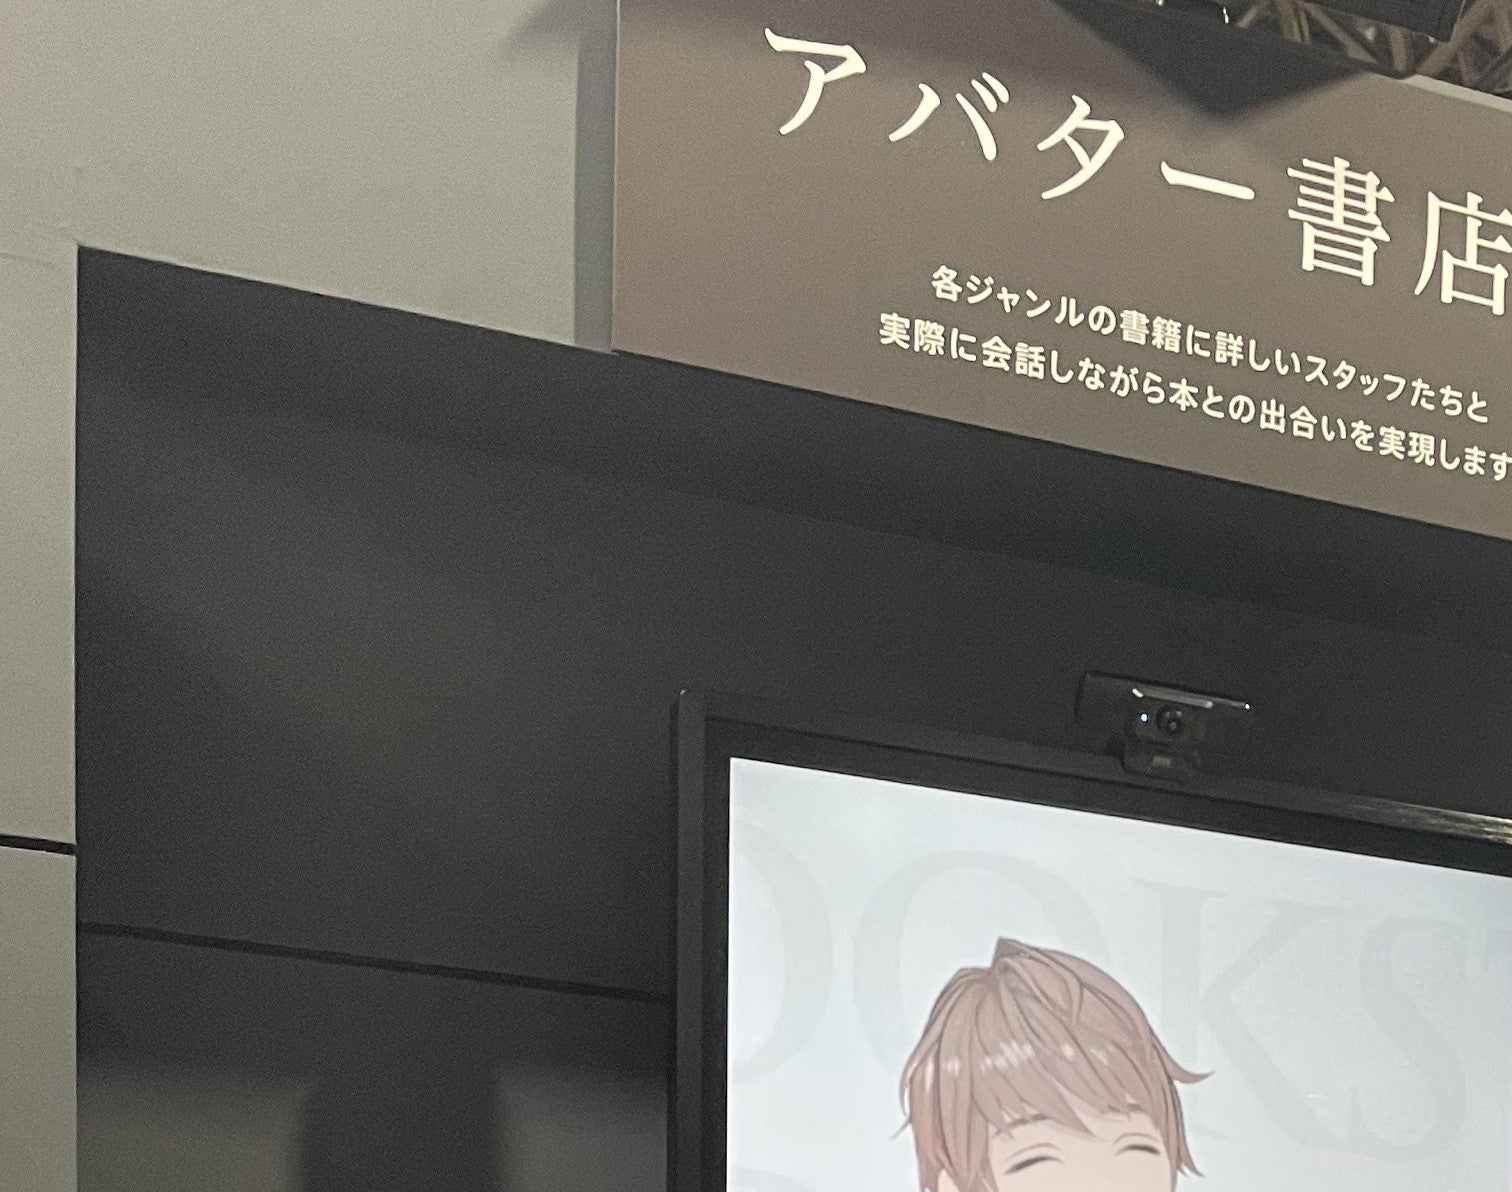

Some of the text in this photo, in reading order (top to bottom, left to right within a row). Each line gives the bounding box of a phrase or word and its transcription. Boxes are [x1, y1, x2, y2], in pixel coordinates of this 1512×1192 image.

[931, 264, 1489, 424] 各ジャンルの書籍に詳しいスタッフたちと
